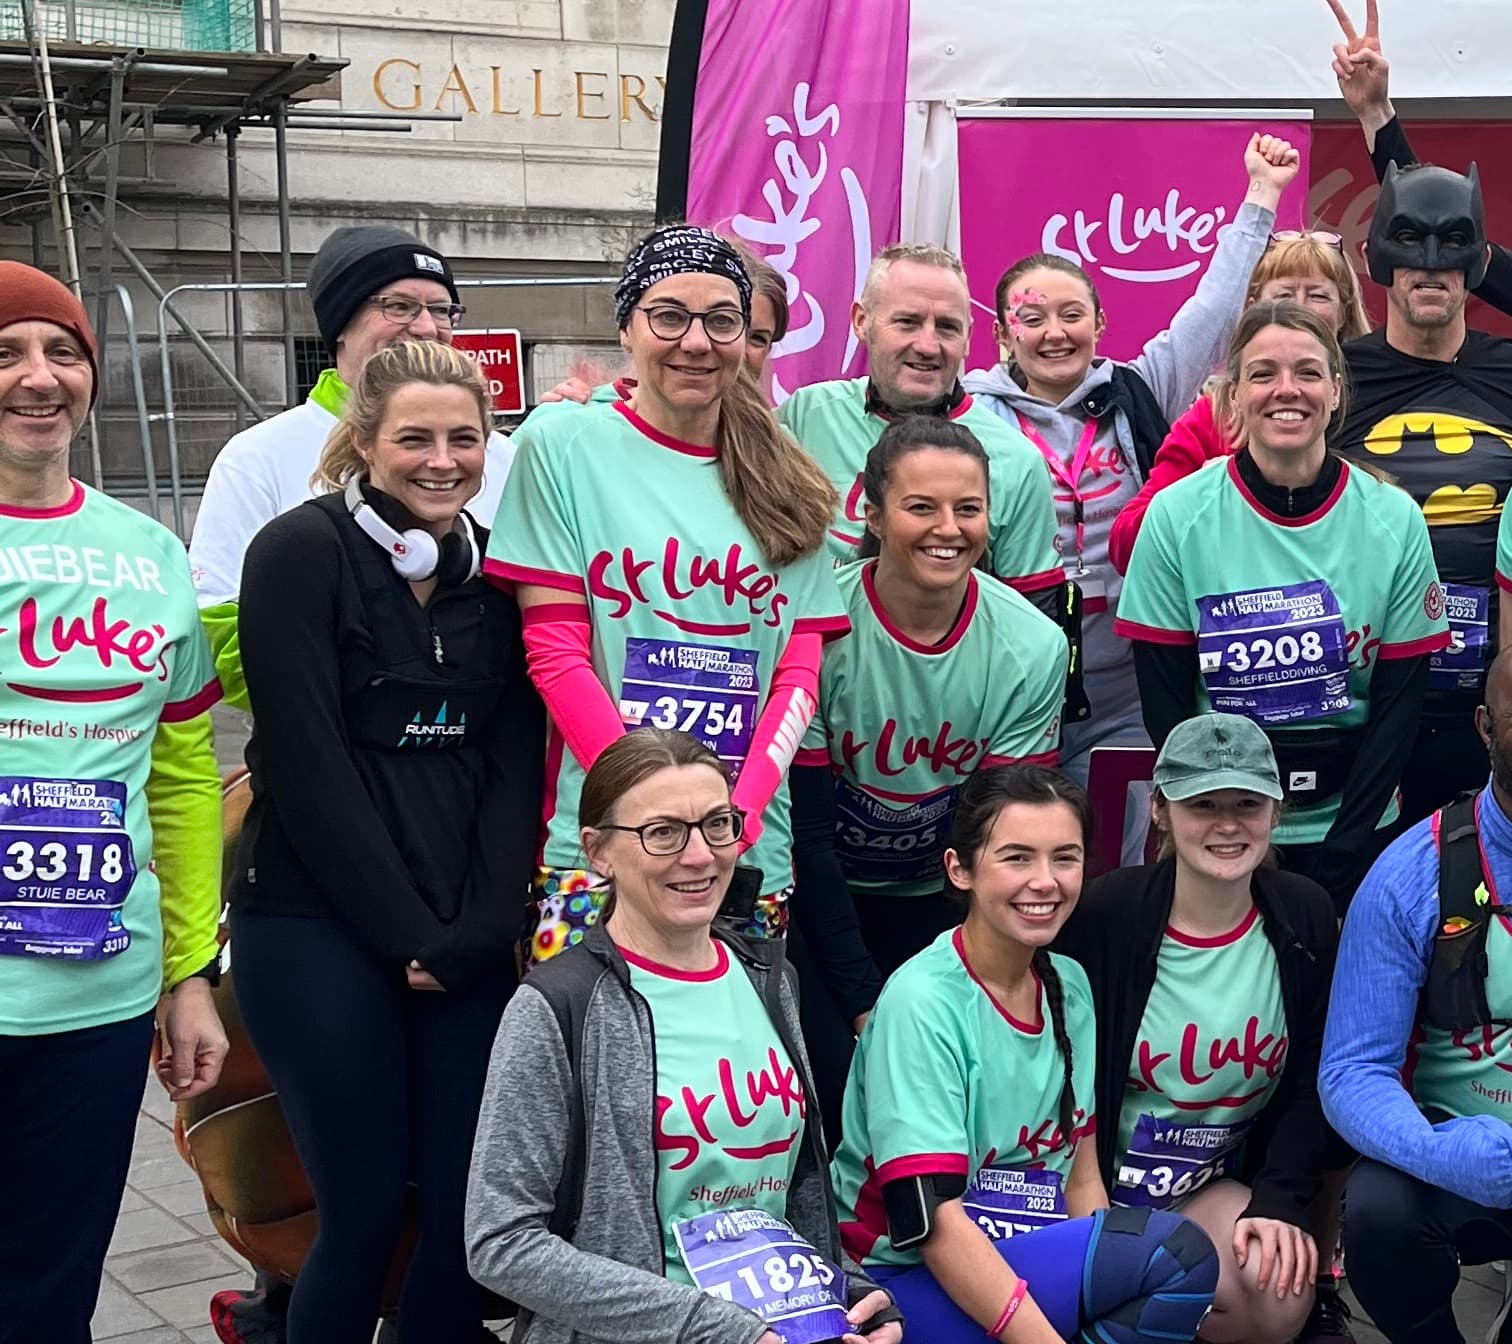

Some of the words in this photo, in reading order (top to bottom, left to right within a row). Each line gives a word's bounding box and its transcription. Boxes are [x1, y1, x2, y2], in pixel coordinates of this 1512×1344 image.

[1108, 188, 1232, 254] Luke'
[464, 348, 512, 365] PATH
[588, 550, 655, 619] St
[662, 536, 790, 628] Luke's
[1236, 592, 1282, 606] SHEFFIELD
[1264, 594, 1322, 610] MARATHON
[1290, 605, 1325, 620] 2023
[1448, 606, 1477, 619] 2023
[18, 596, 174, 682] Luke's
[679, 648, 729, 663] SHEFFIELD
[1226, 631, 1324, 672] 3208
[678, 658, 706, 670] HALF
[707, 664, 753, 675] MARATHON
[728, 675, 753, 688] 2023
[652, 696, 744, 737] 3754
[405, 724, 466, 735] RUNITUDE
[875, 718, 991, 776] Luke'
[34, 797, 66, 808] HALF
[67, 798, 122, 811] MARA
[843, 826, 937, 852] 3405
[2, 840, 124, 884] 3318
[17, 886, 62, 900] STUIE
[65, 888, 106, 901] BEAR
[102, 936, 129, 954] 3318
[656, 1086, 717, 1171] St
[980, 1170, 1025, 1184] SHEFFIELD
[980, 1181, 1004, 1192] HALF
[1004, 1183, 1056, 1198] MARATHON
[1026, 1196, 1055, 1212] 2023
[736, 1253, 835, 1300] 1825
[764, 1294, 816, 1314] MEMORY
